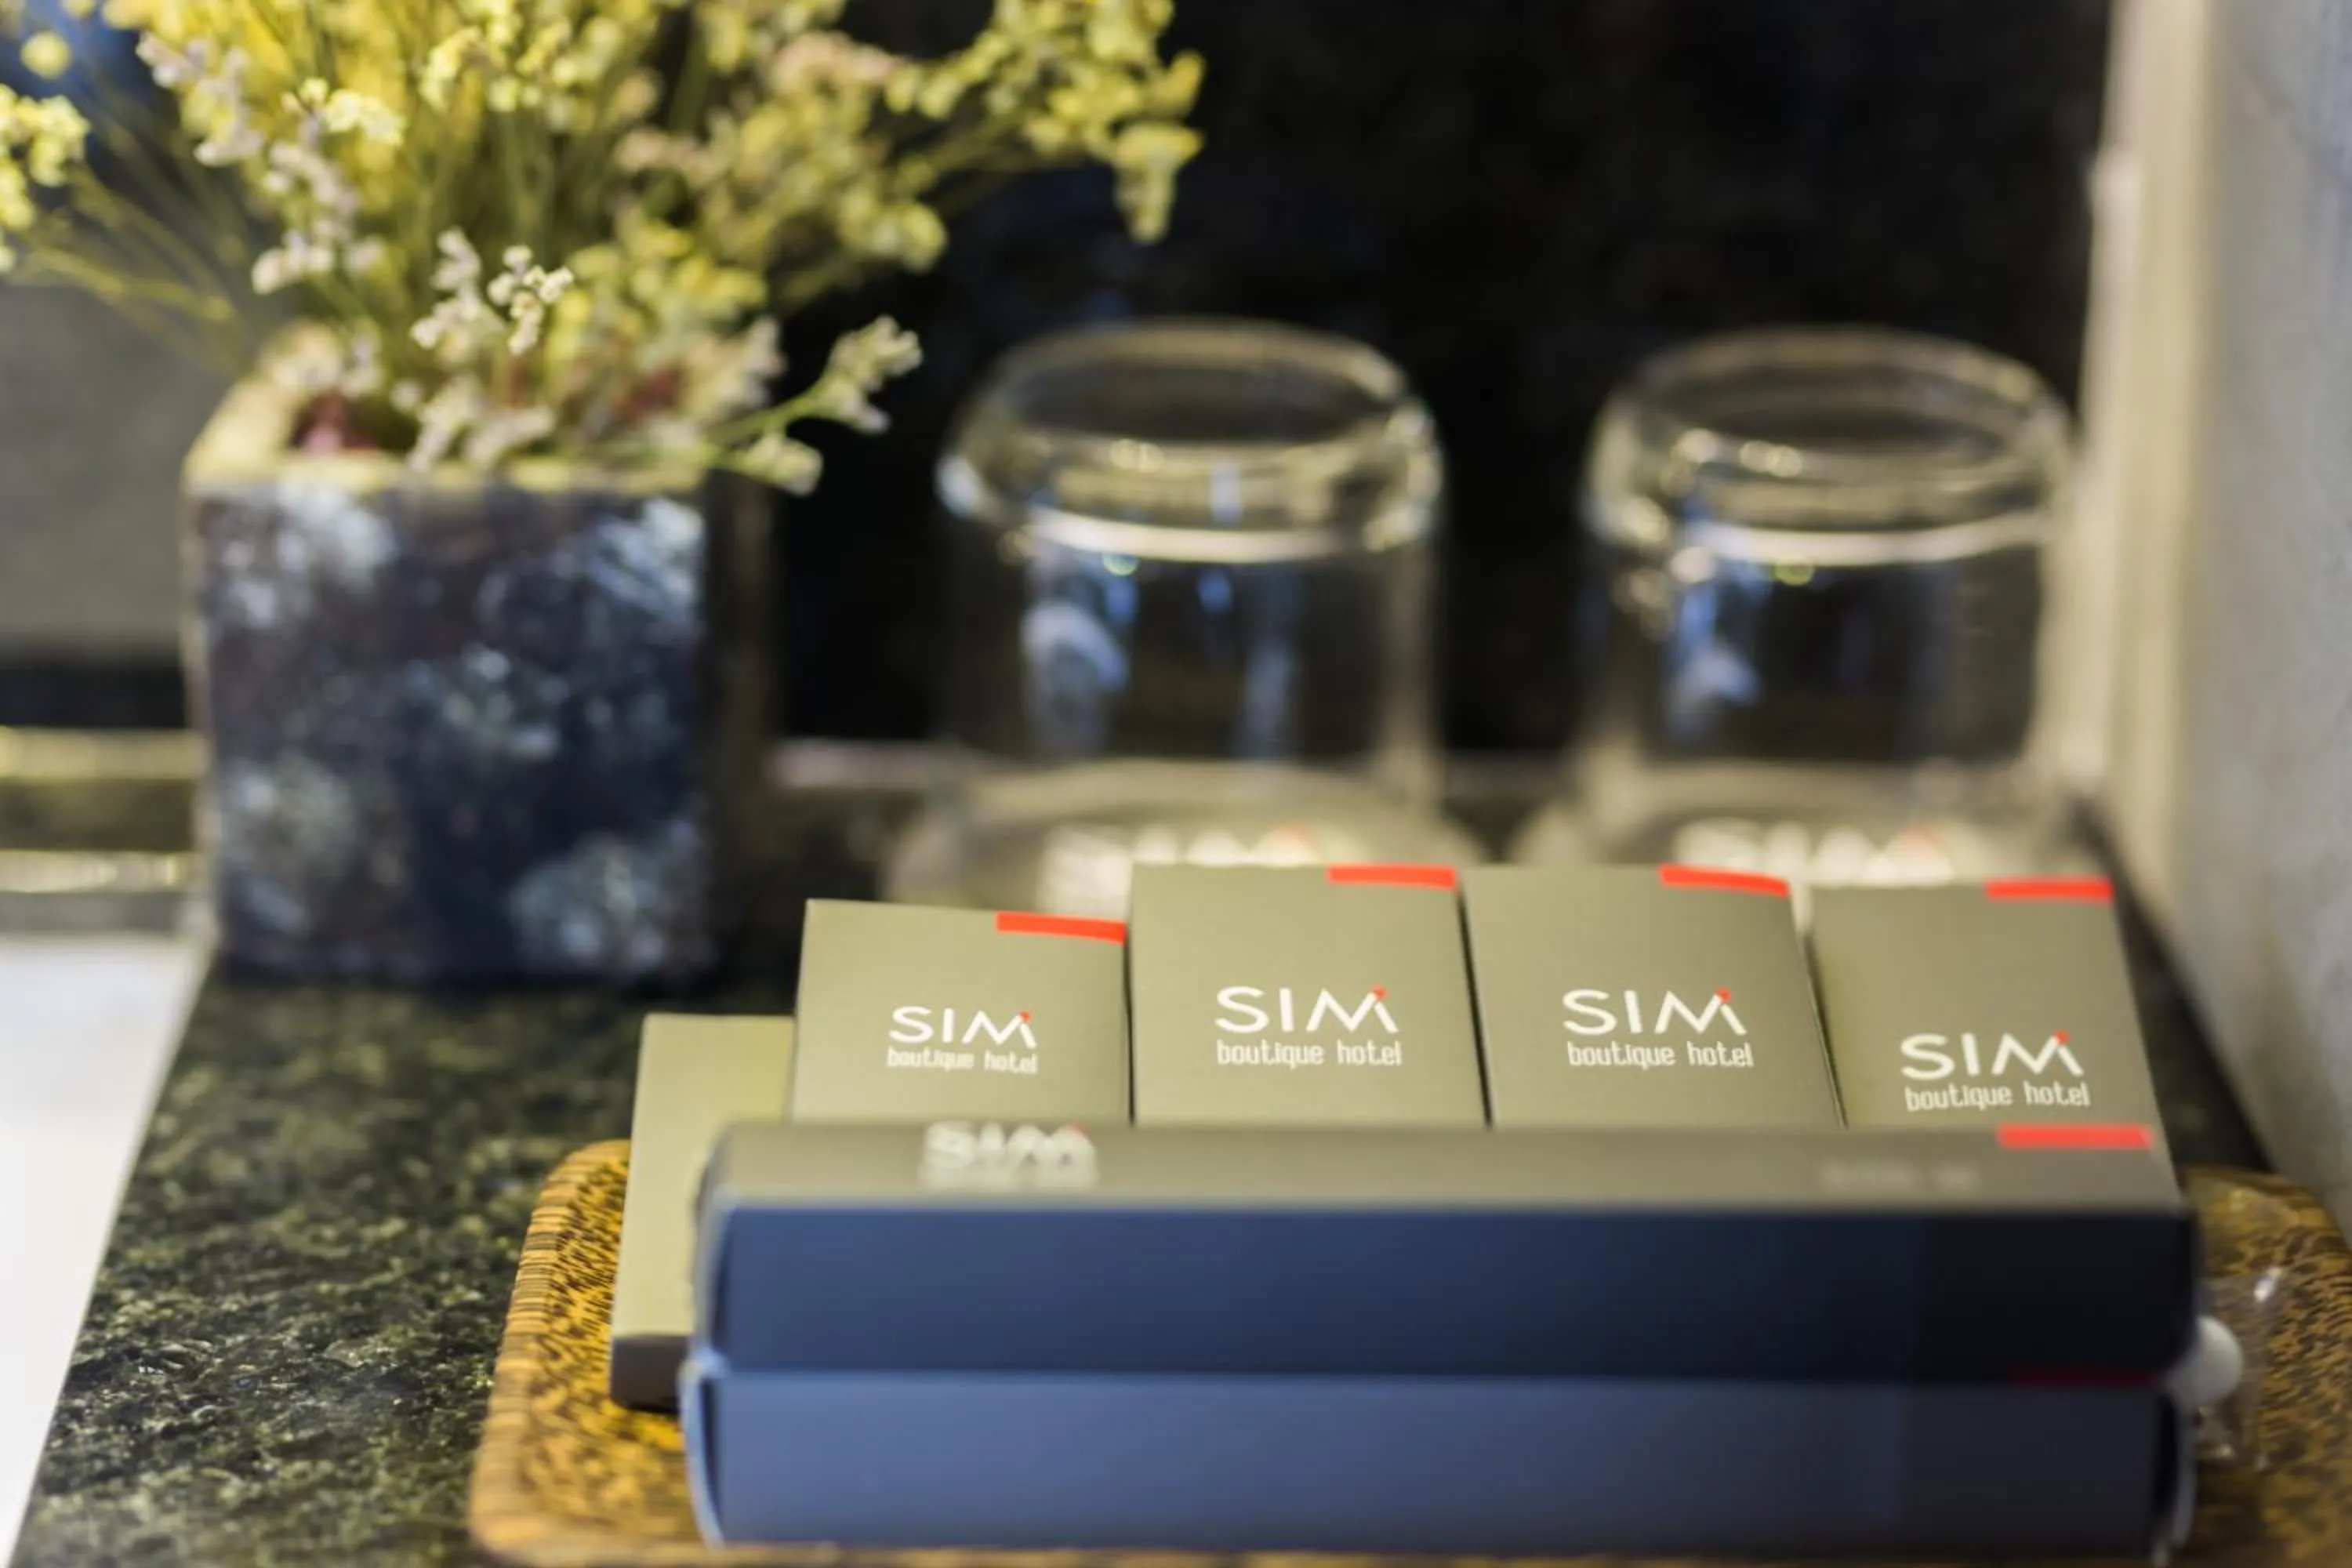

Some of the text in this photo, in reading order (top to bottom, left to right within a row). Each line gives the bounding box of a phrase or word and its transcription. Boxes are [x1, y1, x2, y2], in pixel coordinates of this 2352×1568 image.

[888, 1006, 1037, 1047] SIM
[1215, 985, 1399, 1035] SIM
[1562, 988, 1747, 1036] SIM
[887, 1047, 1039, 1075] boutique hotel
[1216, 1039, 1403, 1069] boutique hotel
[1567, 1041, 1754, 1071] boutique hotel
[1900, 1030, 2085, 1080] SIM
[1905, 1080, 2091, 1112] boutique hotel
